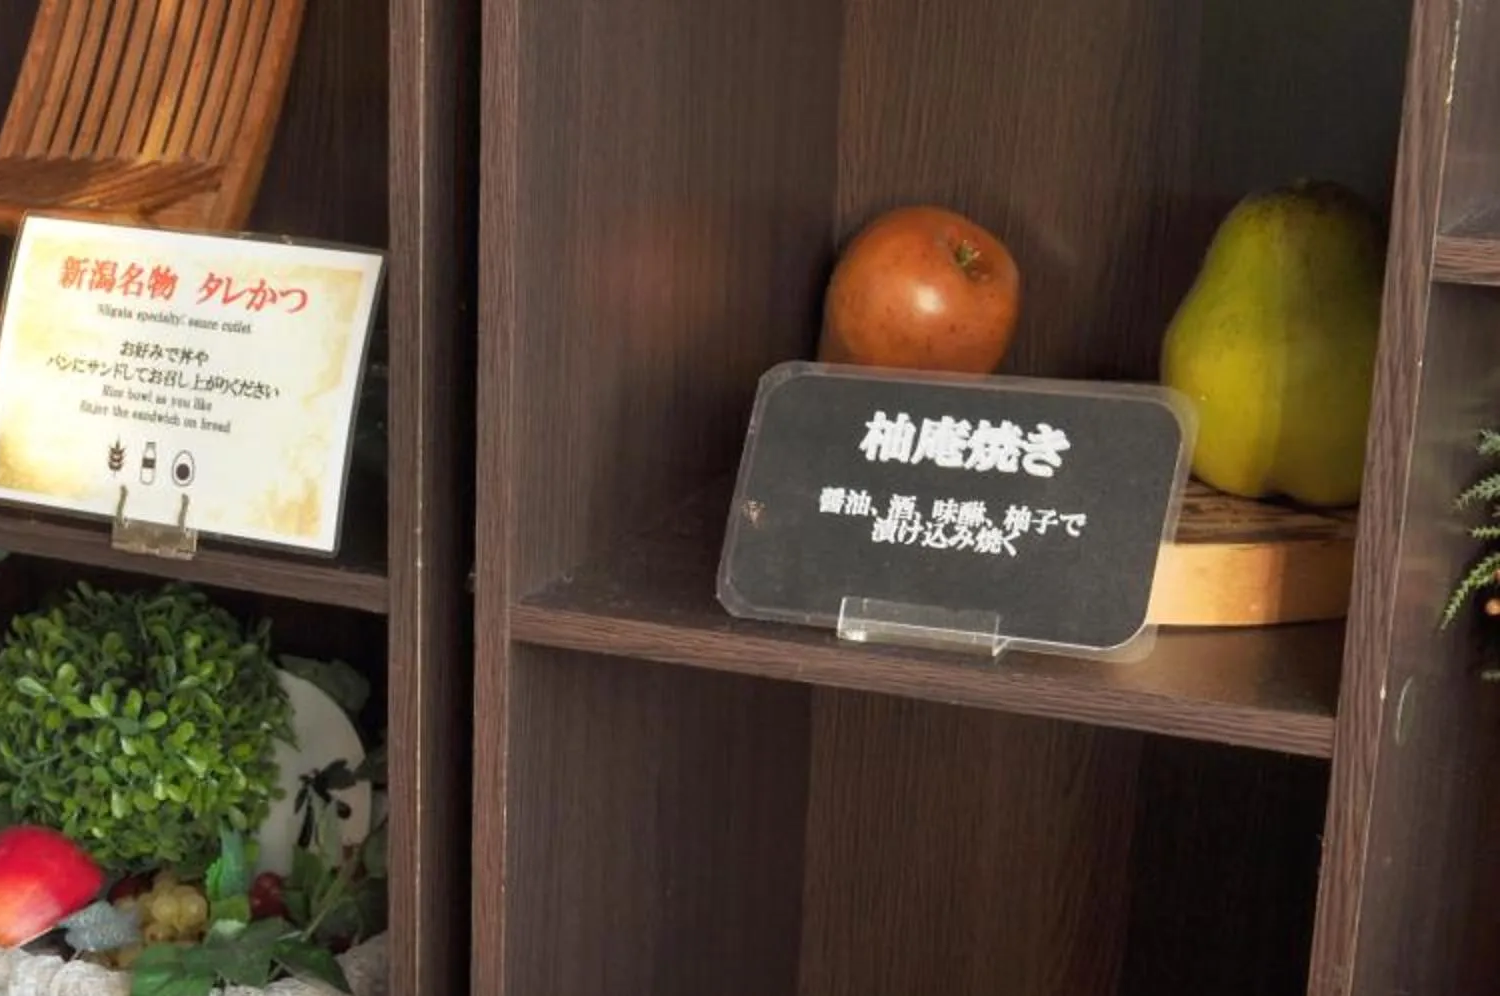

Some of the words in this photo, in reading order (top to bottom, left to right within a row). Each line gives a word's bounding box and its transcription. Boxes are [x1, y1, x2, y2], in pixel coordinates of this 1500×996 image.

[59, 255, 179, 300] 新潟名物
[196, 271, 308, 313] タレかつ
[120, 340, 209, 366] お好みで丼や
[859, 410, 1071, 477] 柚庵焼き
[872, 514, 1020, 557] 漬け込み焼く
